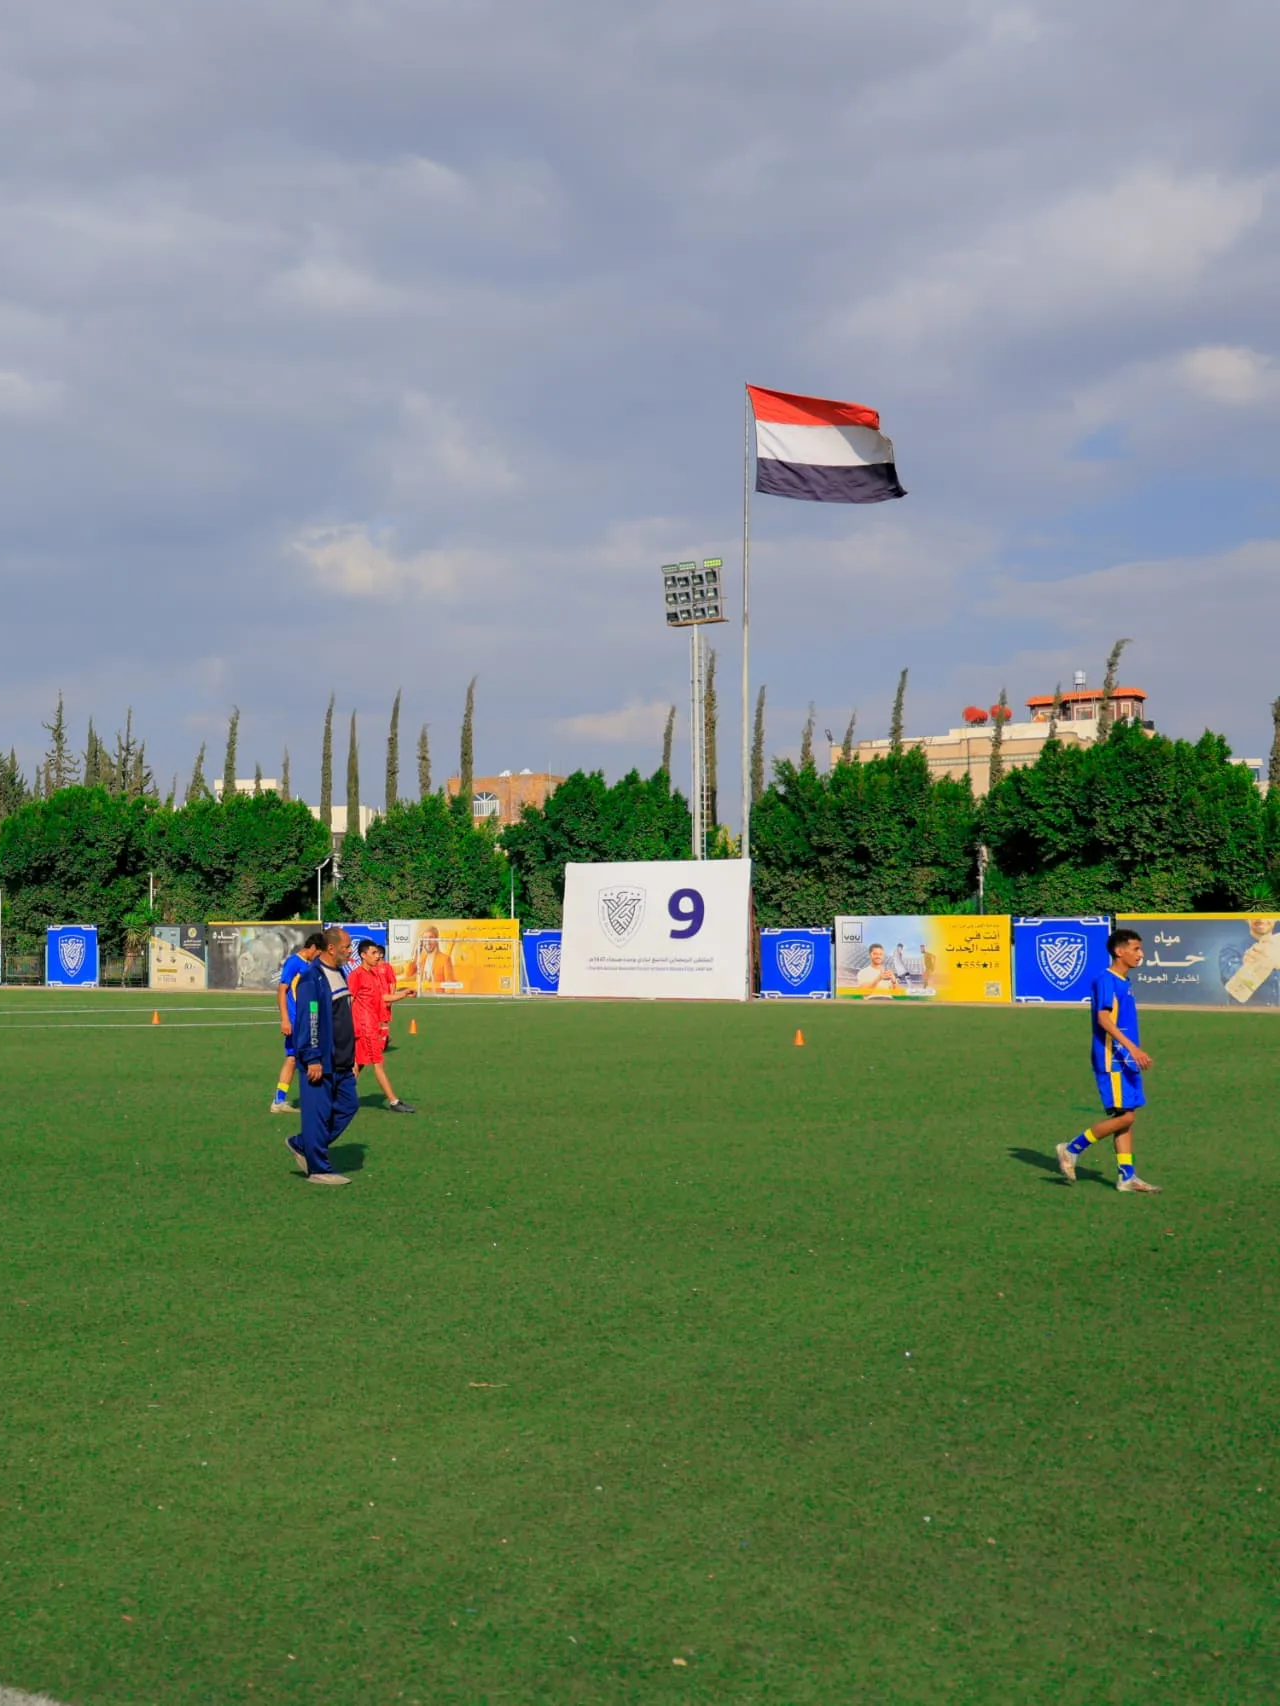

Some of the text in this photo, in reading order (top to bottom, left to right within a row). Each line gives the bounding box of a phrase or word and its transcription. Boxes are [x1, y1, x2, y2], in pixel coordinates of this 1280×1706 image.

[668, 888, 705, 939] 9
[1154, 930, 1181, 947] مياه
[1137, 973, 1168, 984] الجودة
